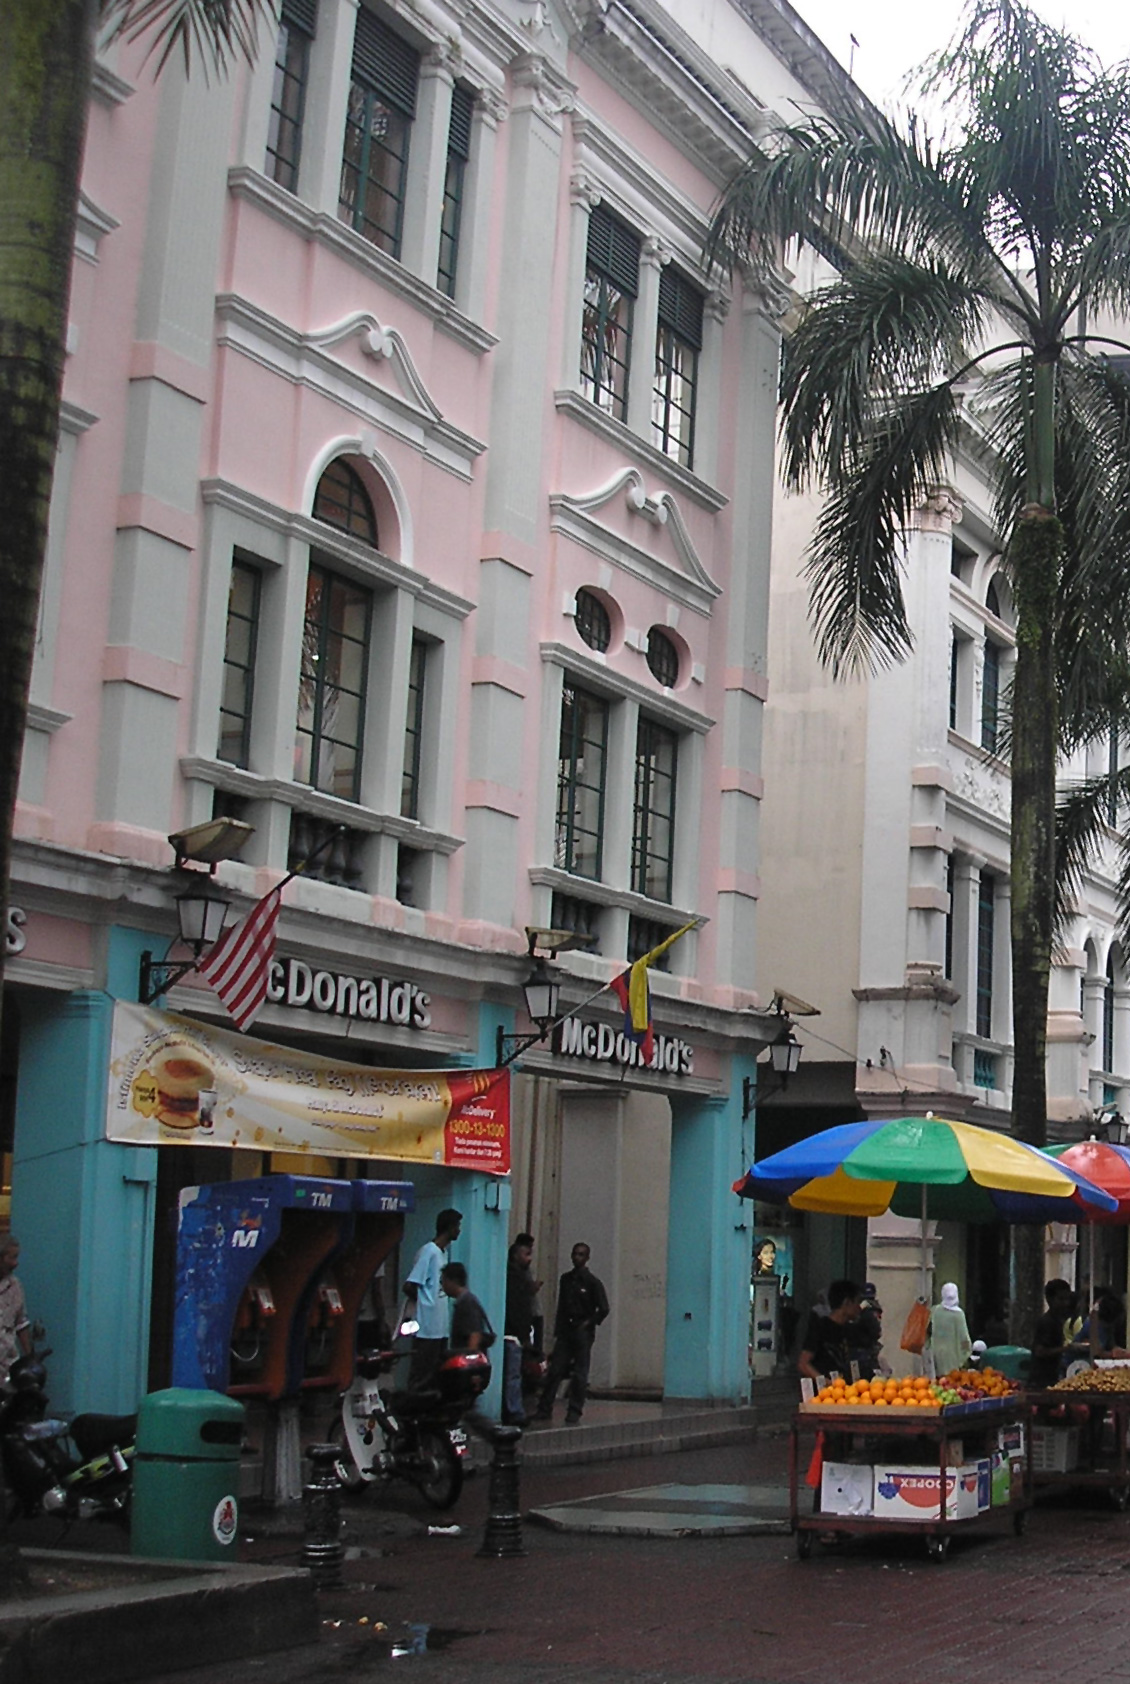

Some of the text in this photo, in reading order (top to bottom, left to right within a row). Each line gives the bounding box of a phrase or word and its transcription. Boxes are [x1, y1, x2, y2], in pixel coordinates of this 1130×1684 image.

[266, 958, 432, 1029] cDonald's
[311, 1192, 333, 1208] TM
[380, 1197, 399, 1211] TM
